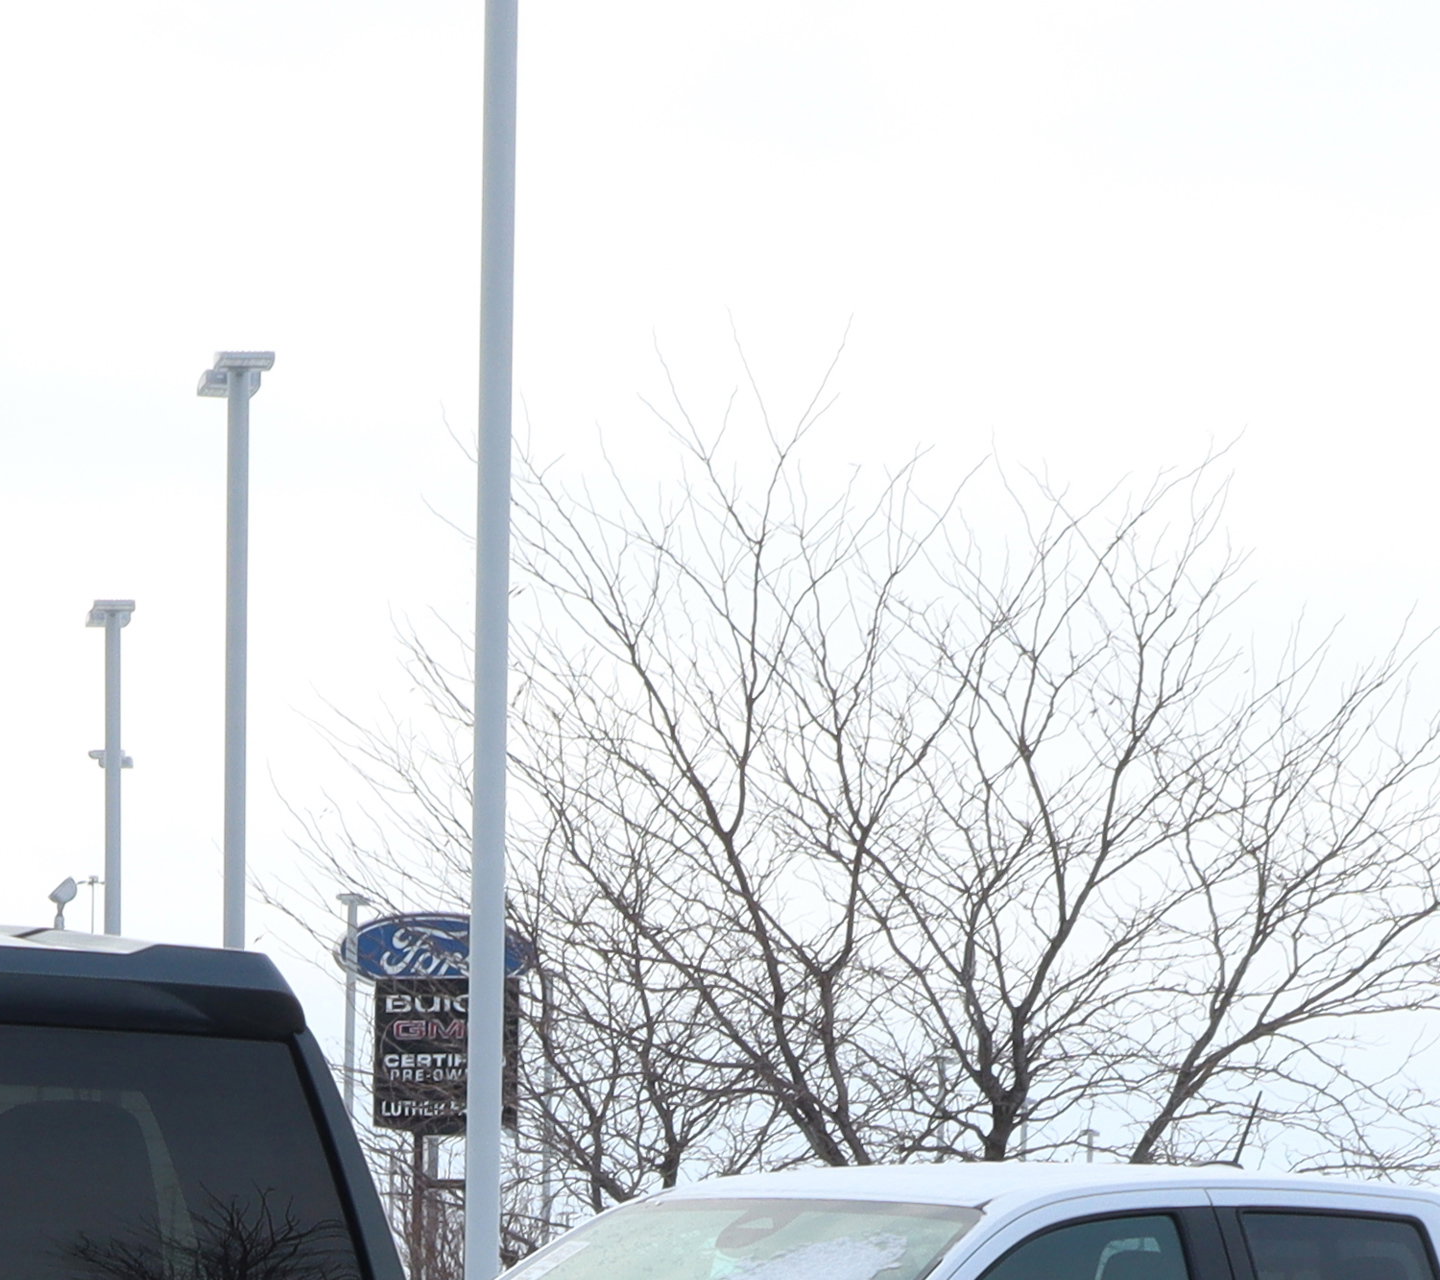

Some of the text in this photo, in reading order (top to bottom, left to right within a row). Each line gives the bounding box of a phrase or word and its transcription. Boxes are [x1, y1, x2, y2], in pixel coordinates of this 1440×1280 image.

[380, 926, 469, 976] For
[393, 1019, 465, 1040] GM
[384, 1053, 507, 1068] CERTIF
[390, 1069, 468, 1082] PRE-OW
